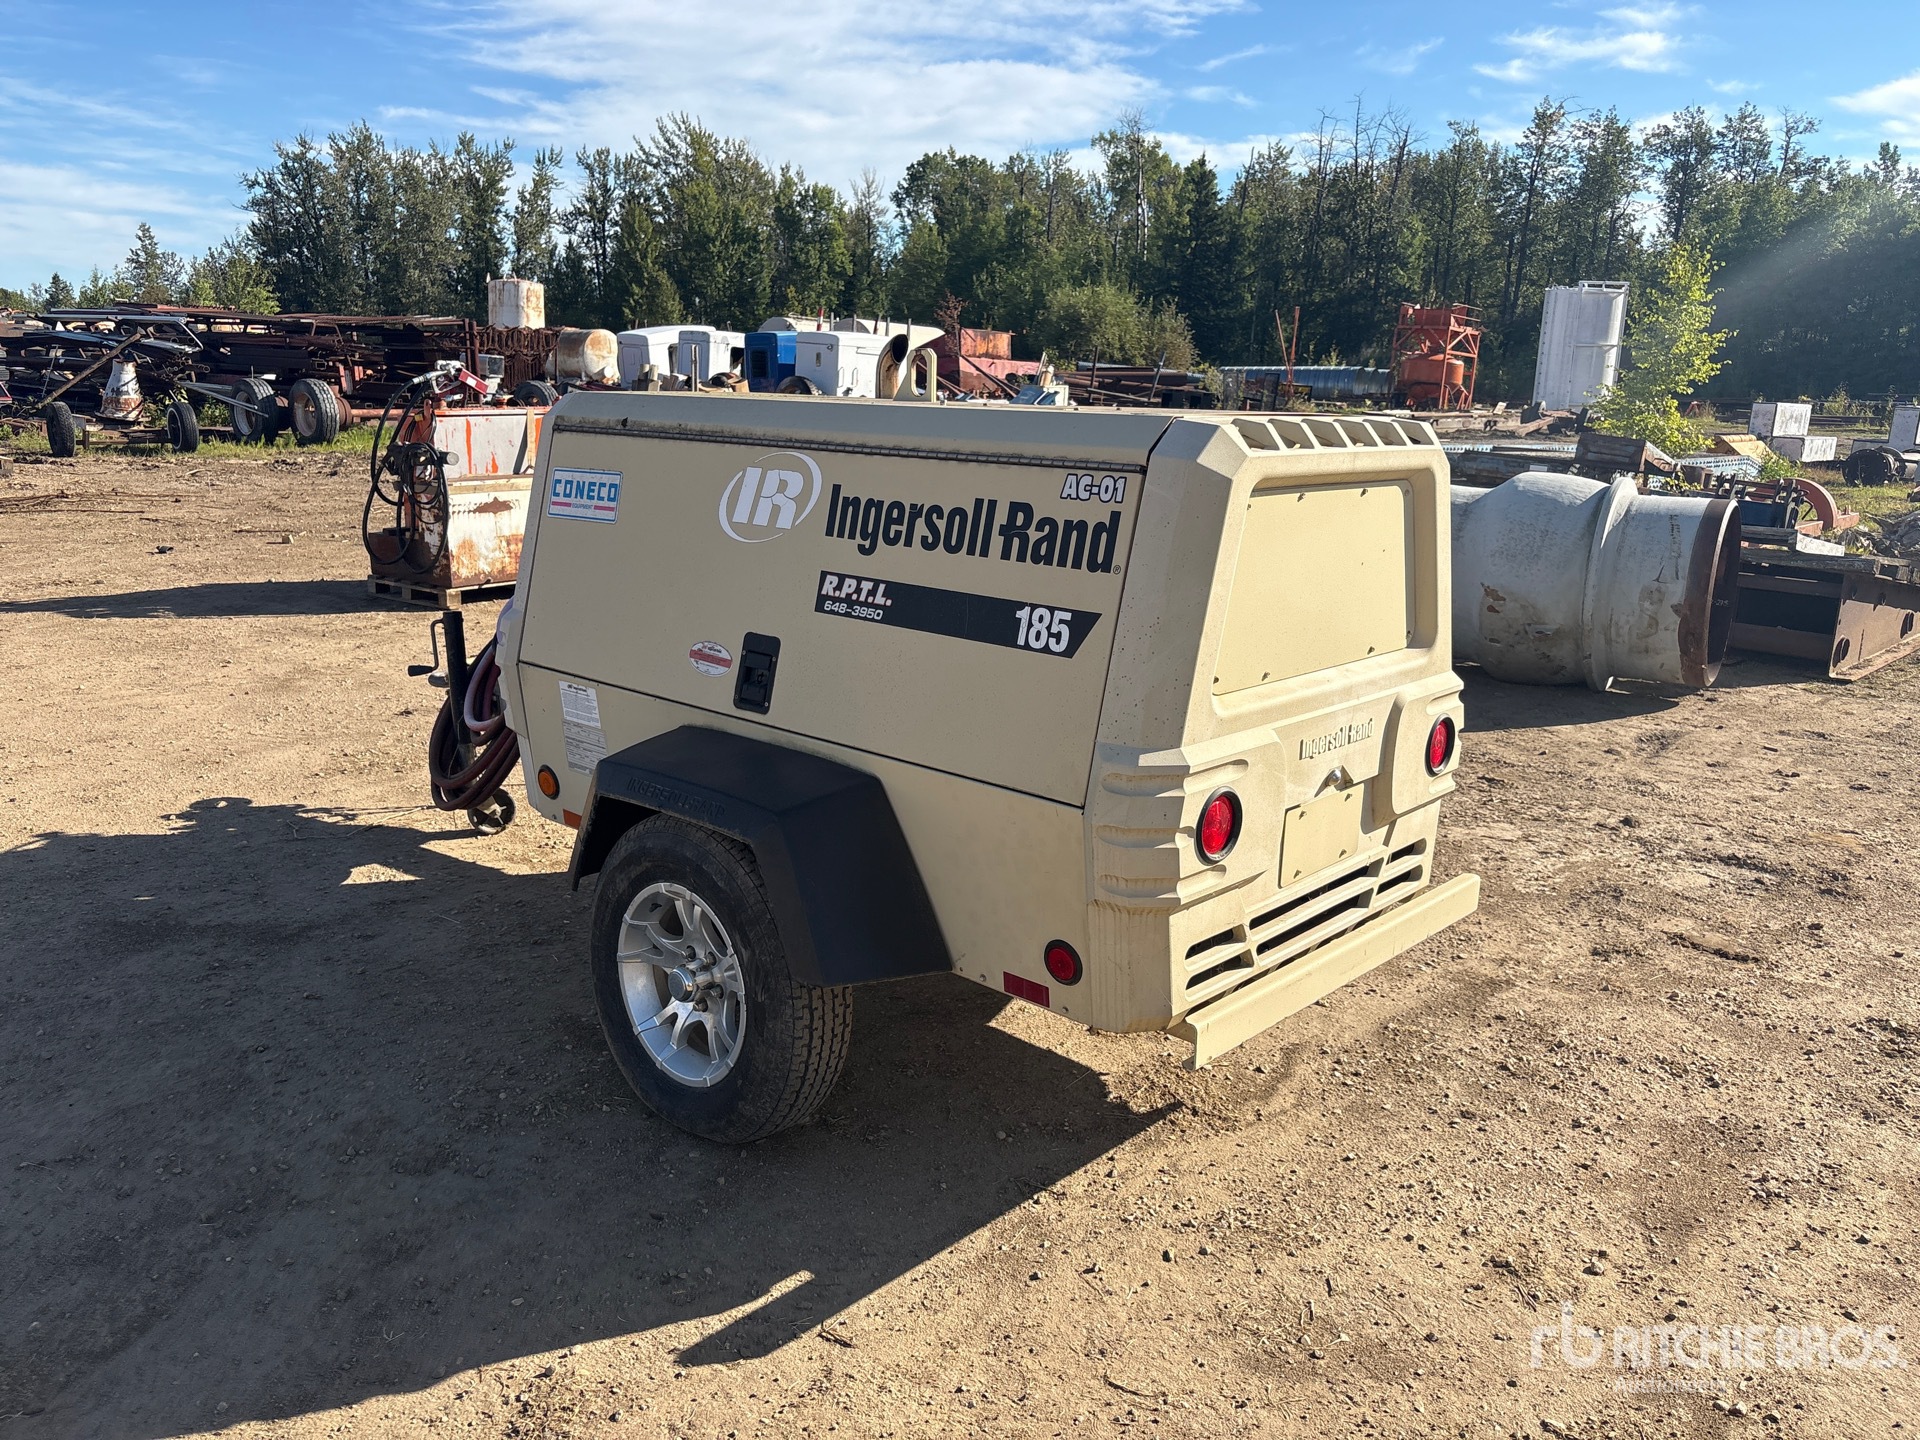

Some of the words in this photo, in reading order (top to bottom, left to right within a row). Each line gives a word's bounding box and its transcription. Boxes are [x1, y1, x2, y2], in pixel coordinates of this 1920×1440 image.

[553, 478, 618, 502] CONECO
[732, 466, 804, 530] IR
[1060, 473, 1128, 503] AC-01
[821, 574, 892, 607] R.P.T.L.
[823, 600, 884, 620] 648-3950
[1015, 605, 1073, 653] 185
